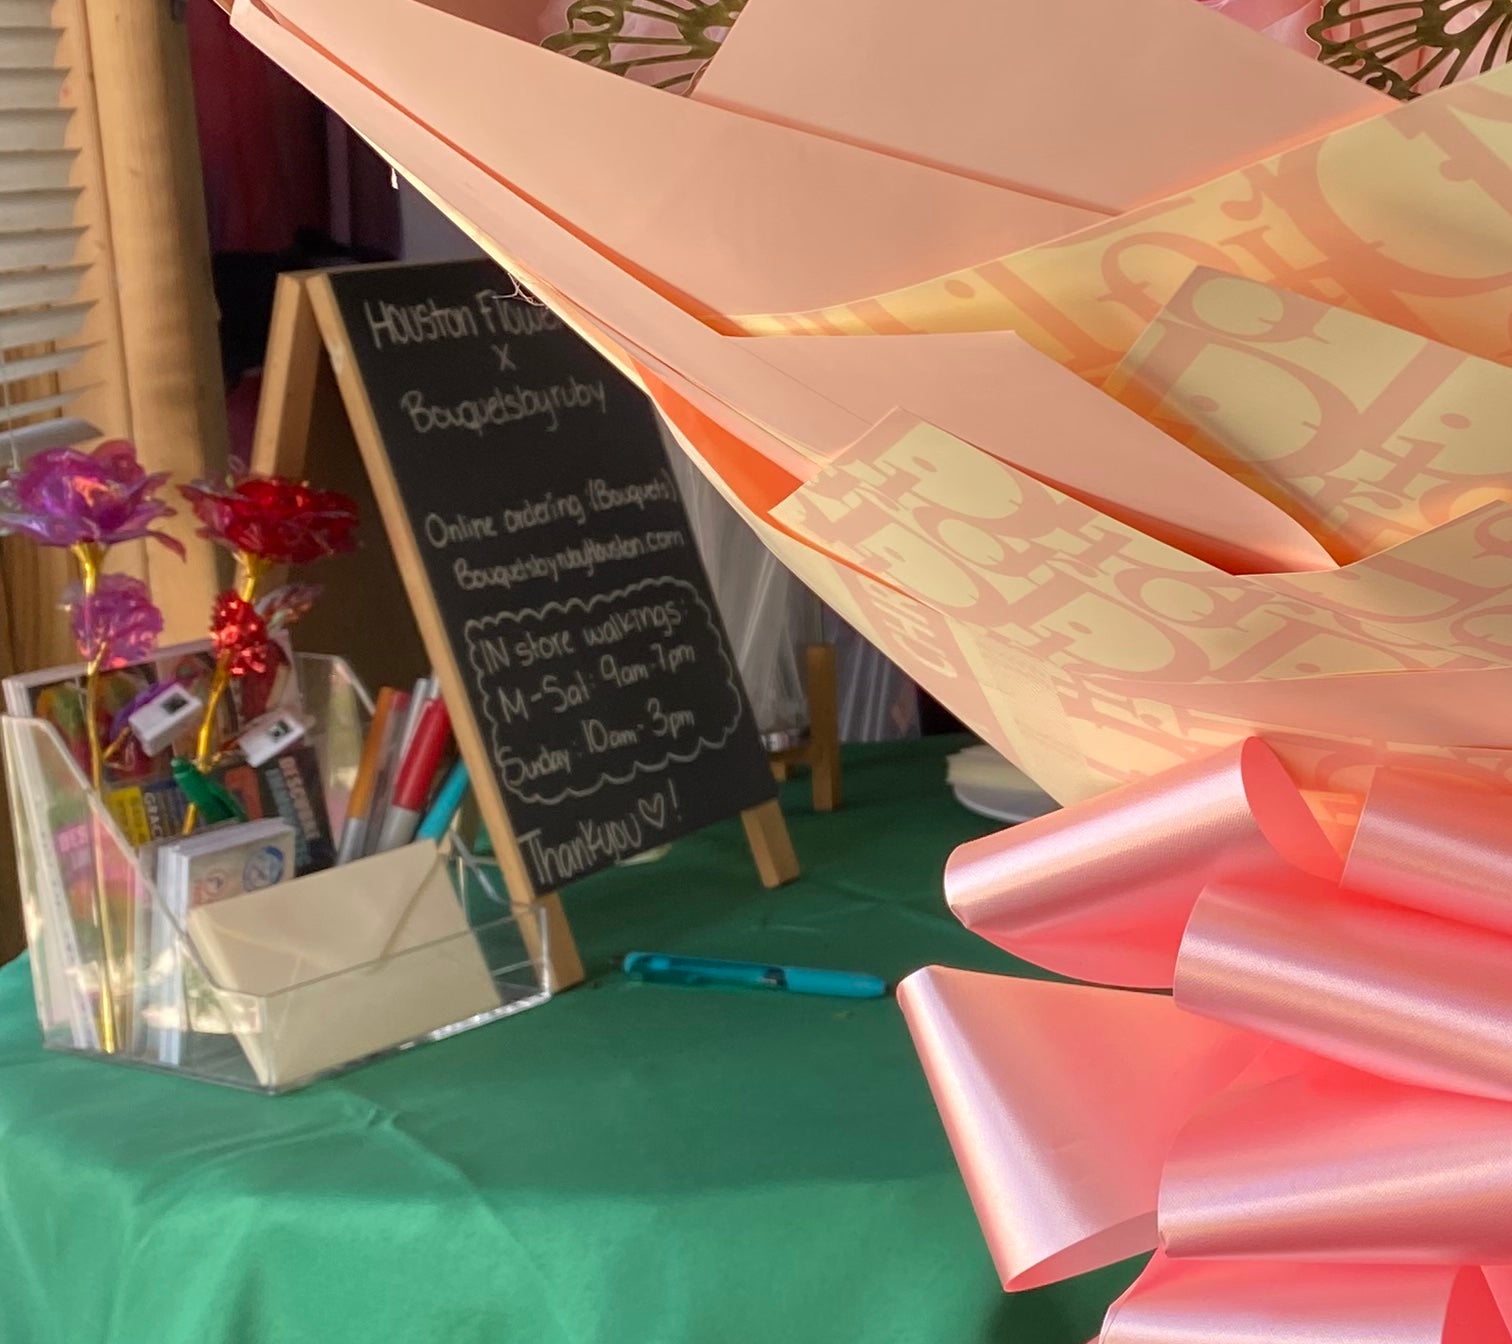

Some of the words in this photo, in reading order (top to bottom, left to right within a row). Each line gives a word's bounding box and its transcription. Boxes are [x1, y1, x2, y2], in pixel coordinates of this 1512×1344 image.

[363, 297, 478, 350] Houston
[425, 511, 498, 549] Online
[515, 631, 575, 667] store
